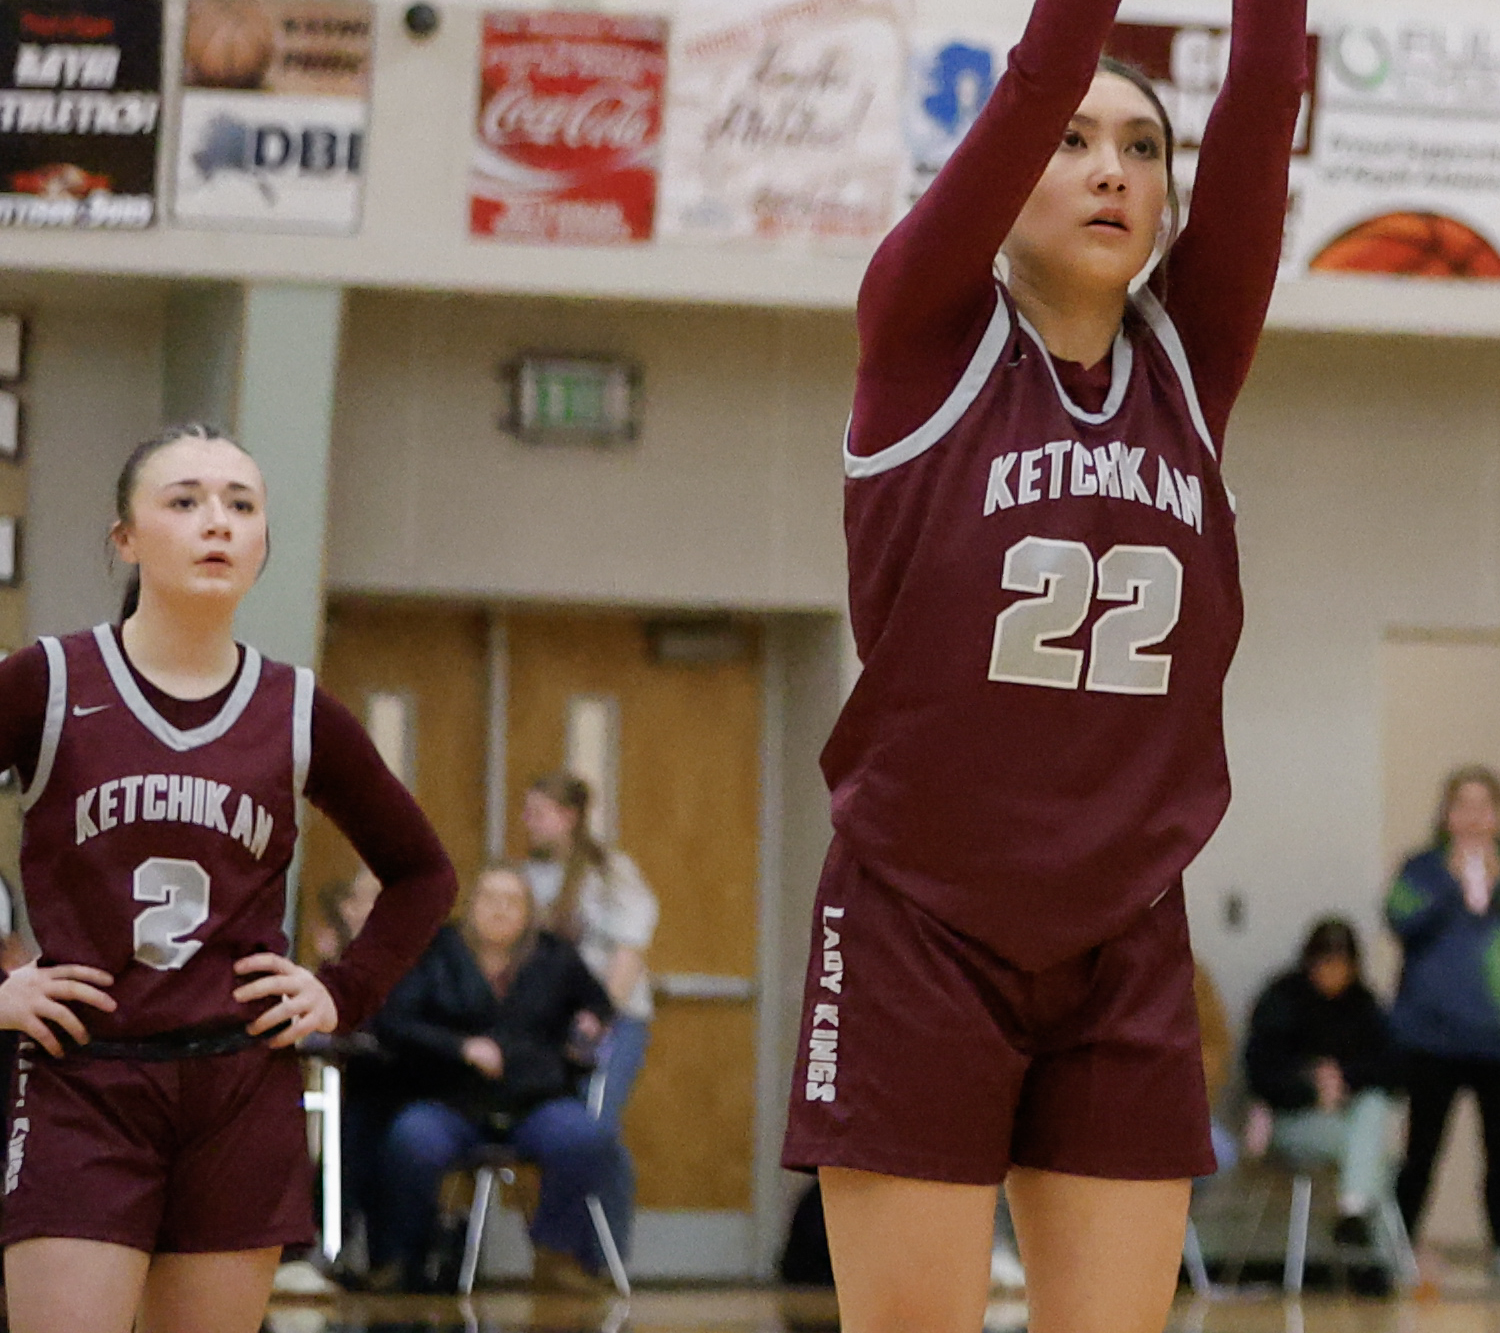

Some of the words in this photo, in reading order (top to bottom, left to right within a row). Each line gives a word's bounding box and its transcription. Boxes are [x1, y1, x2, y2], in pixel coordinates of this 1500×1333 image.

[983, 440, 1202, 536] KETCHKAN
[987, 535, 1184, 695] 22
[75, 773, 275, 861] KETCHIKAN
[133, 856, 211, 971] 2
[822, 905, 846, 995] LADY
[804, 1002, 841, 1105] KINGS
